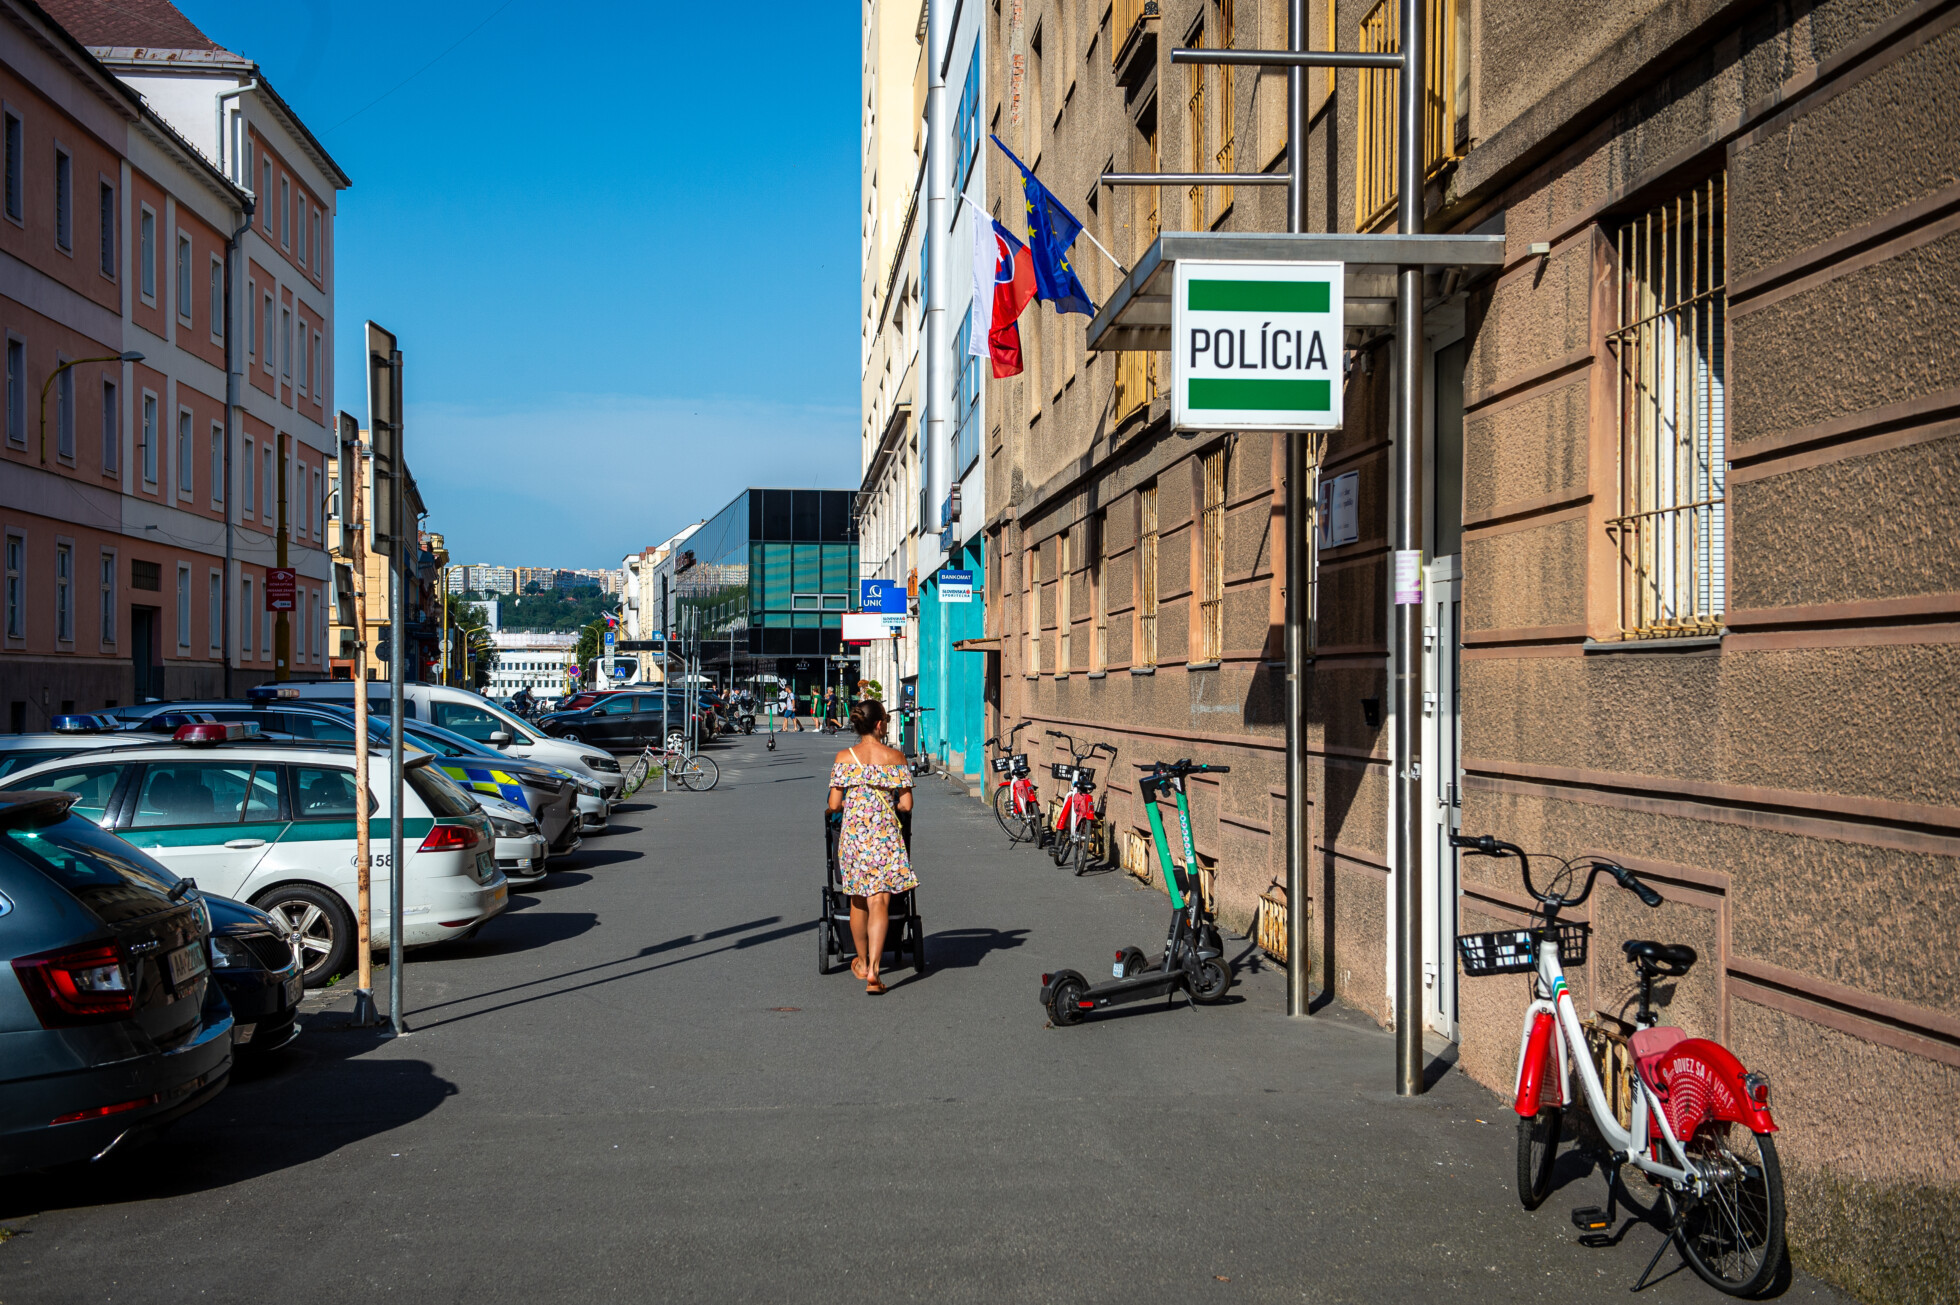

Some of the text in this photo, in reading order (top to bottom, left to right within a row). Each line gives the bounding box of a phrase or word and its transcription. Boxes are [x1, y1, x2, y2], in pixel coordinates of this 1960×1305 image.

[1190, 321, 1329, 370] POLÍCIA
[606, 633, 613, 642] P
[907, 686, 913, 695] P
[1673, 1057, 1695, 1074] ODVEZ
[1695, 1061, 1705, 1079] SA
[1706, 1070, 1712, 1085] A
